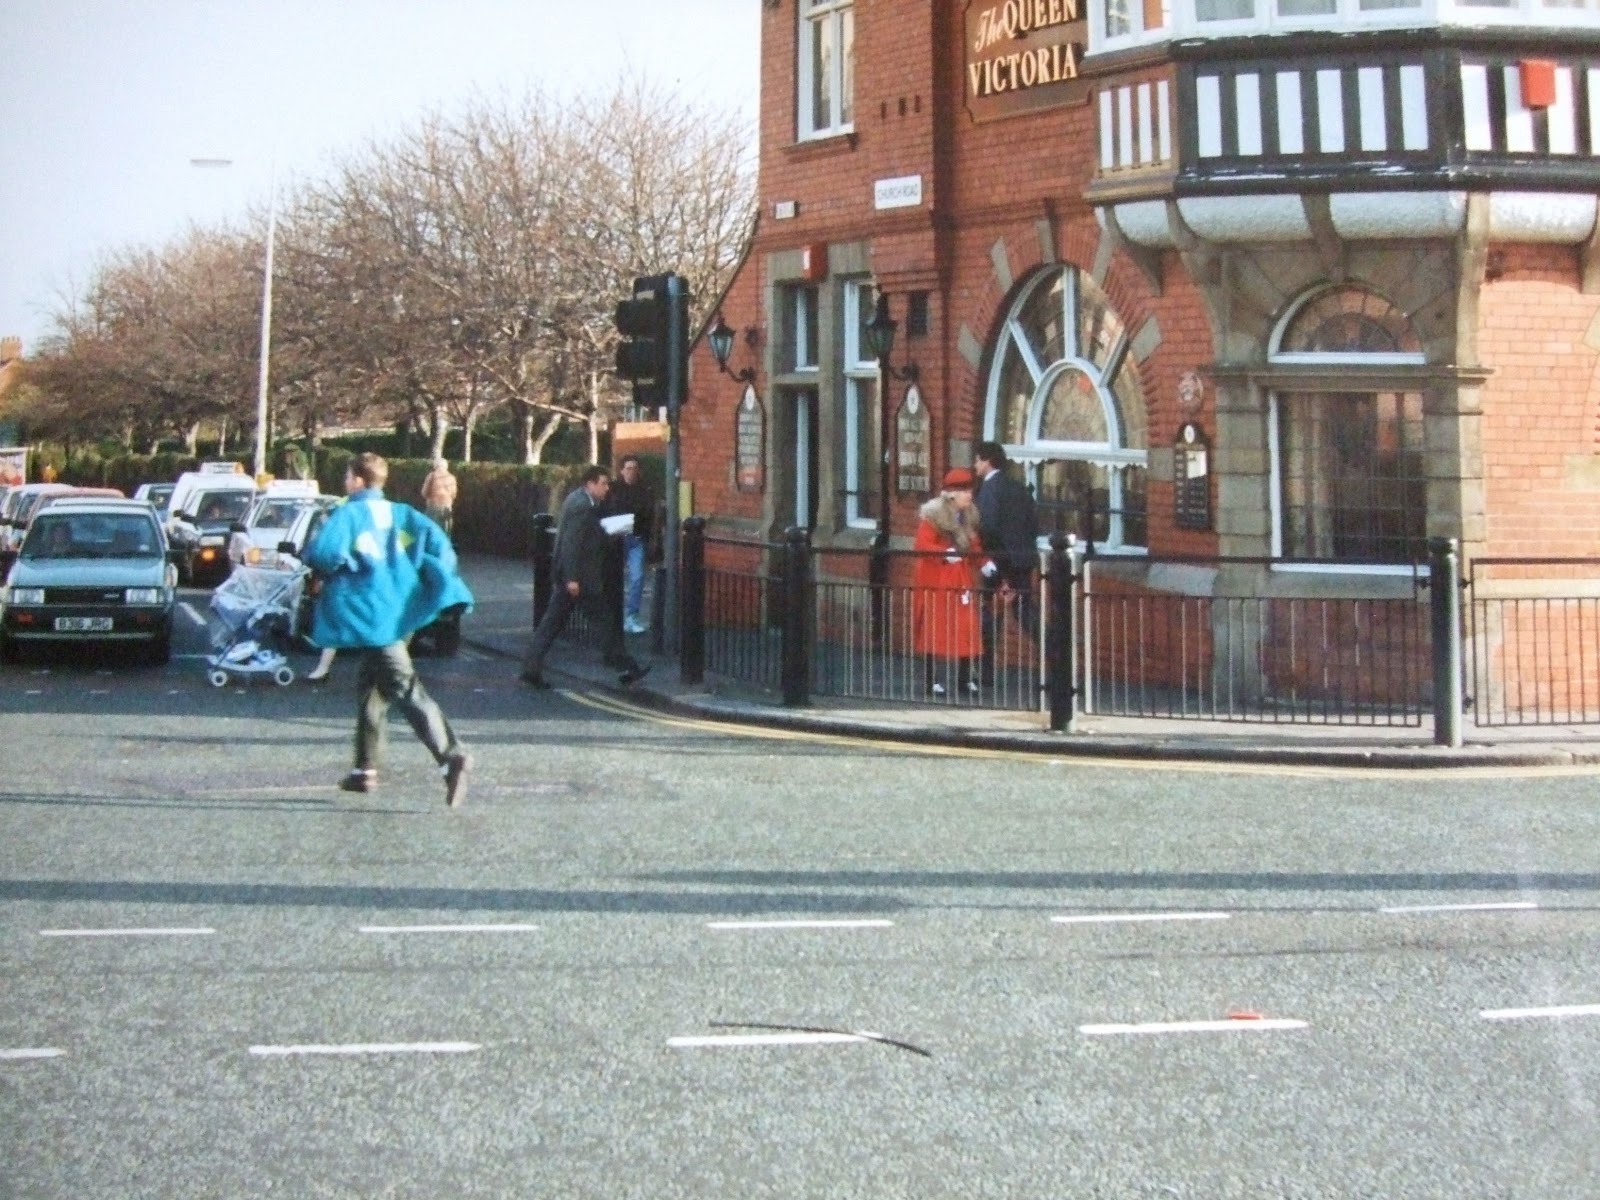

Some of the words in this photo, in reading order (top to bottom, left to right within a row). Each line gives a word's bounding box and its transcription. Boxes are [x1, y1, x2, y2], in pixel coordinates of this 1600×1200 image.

[974, 7, 1003, 52] The
[1002, 0, 1077, 39] QUEEN
[969, 43, 1077, 96] VICTORIA
